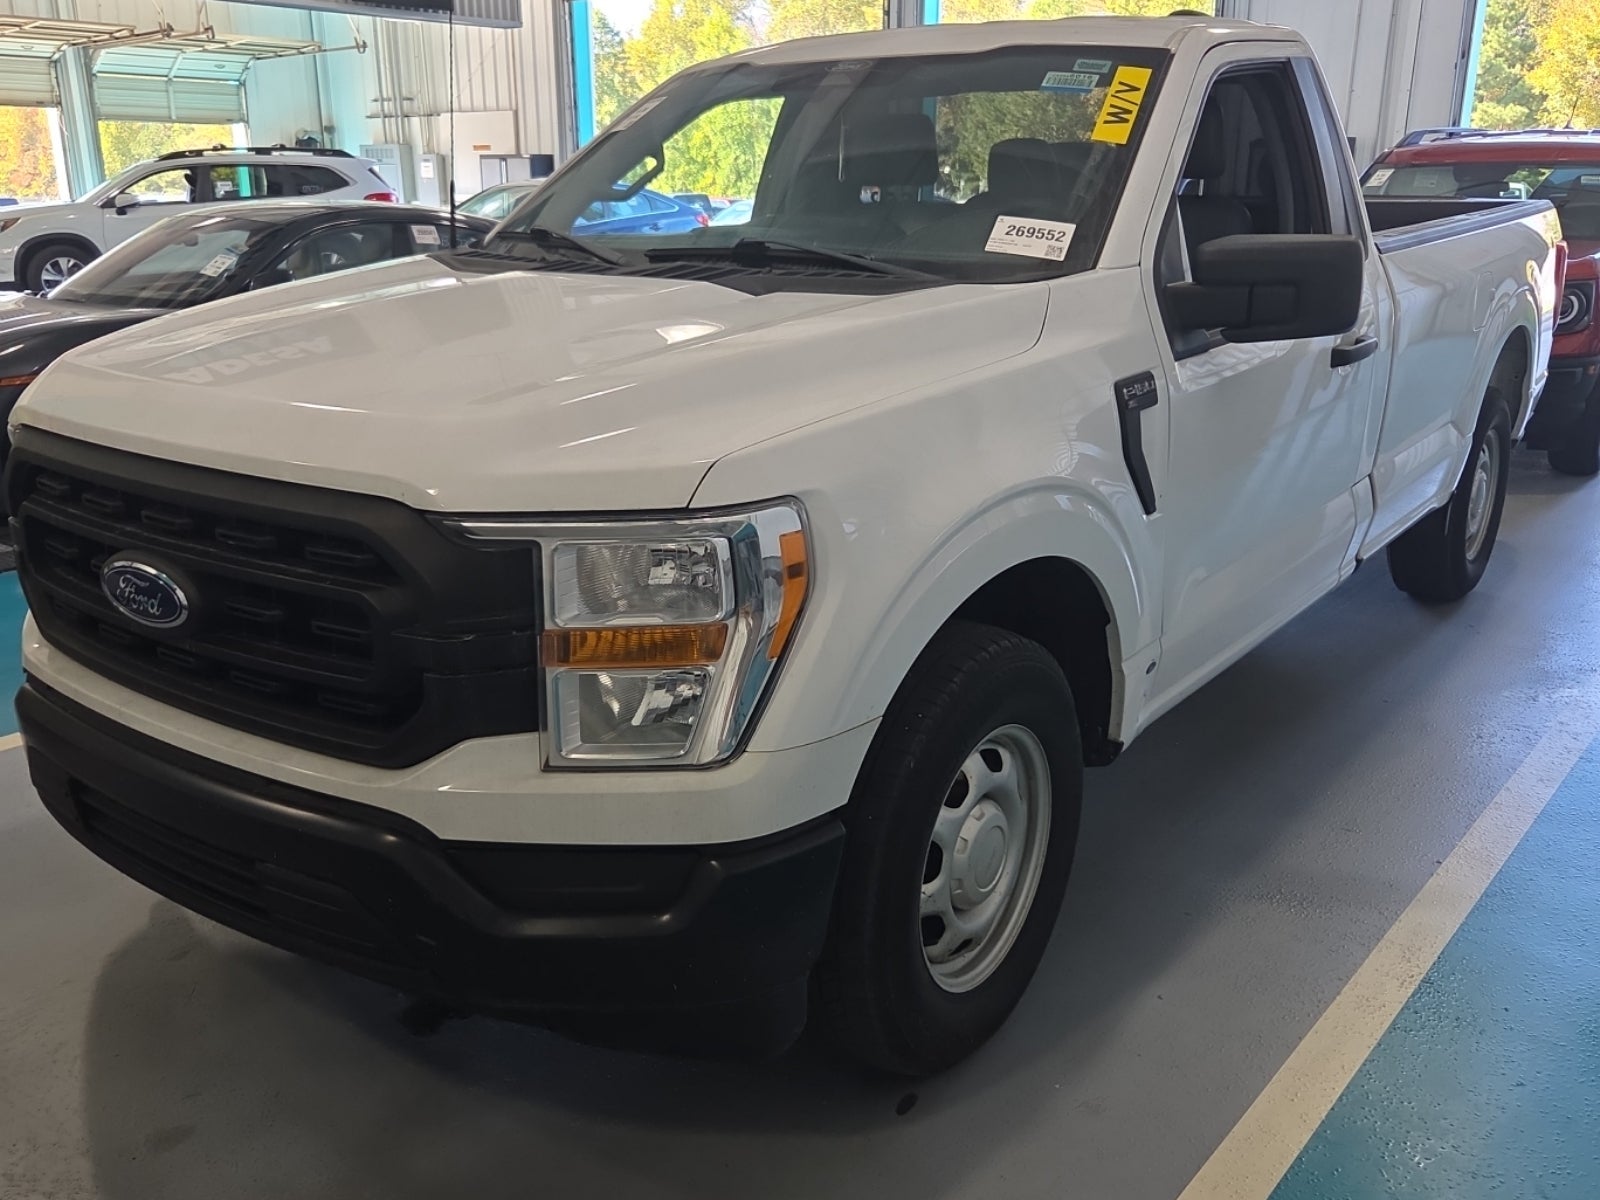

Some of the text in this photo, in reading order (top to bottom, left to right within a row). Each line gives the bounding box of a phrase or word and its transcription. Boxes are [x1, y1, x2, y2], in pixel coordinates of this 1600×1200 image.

[1102, 80, 1141, 125] W/V
[1004, 224, 1067, 243] 269552
[116, 573, 163, 616] Ford
